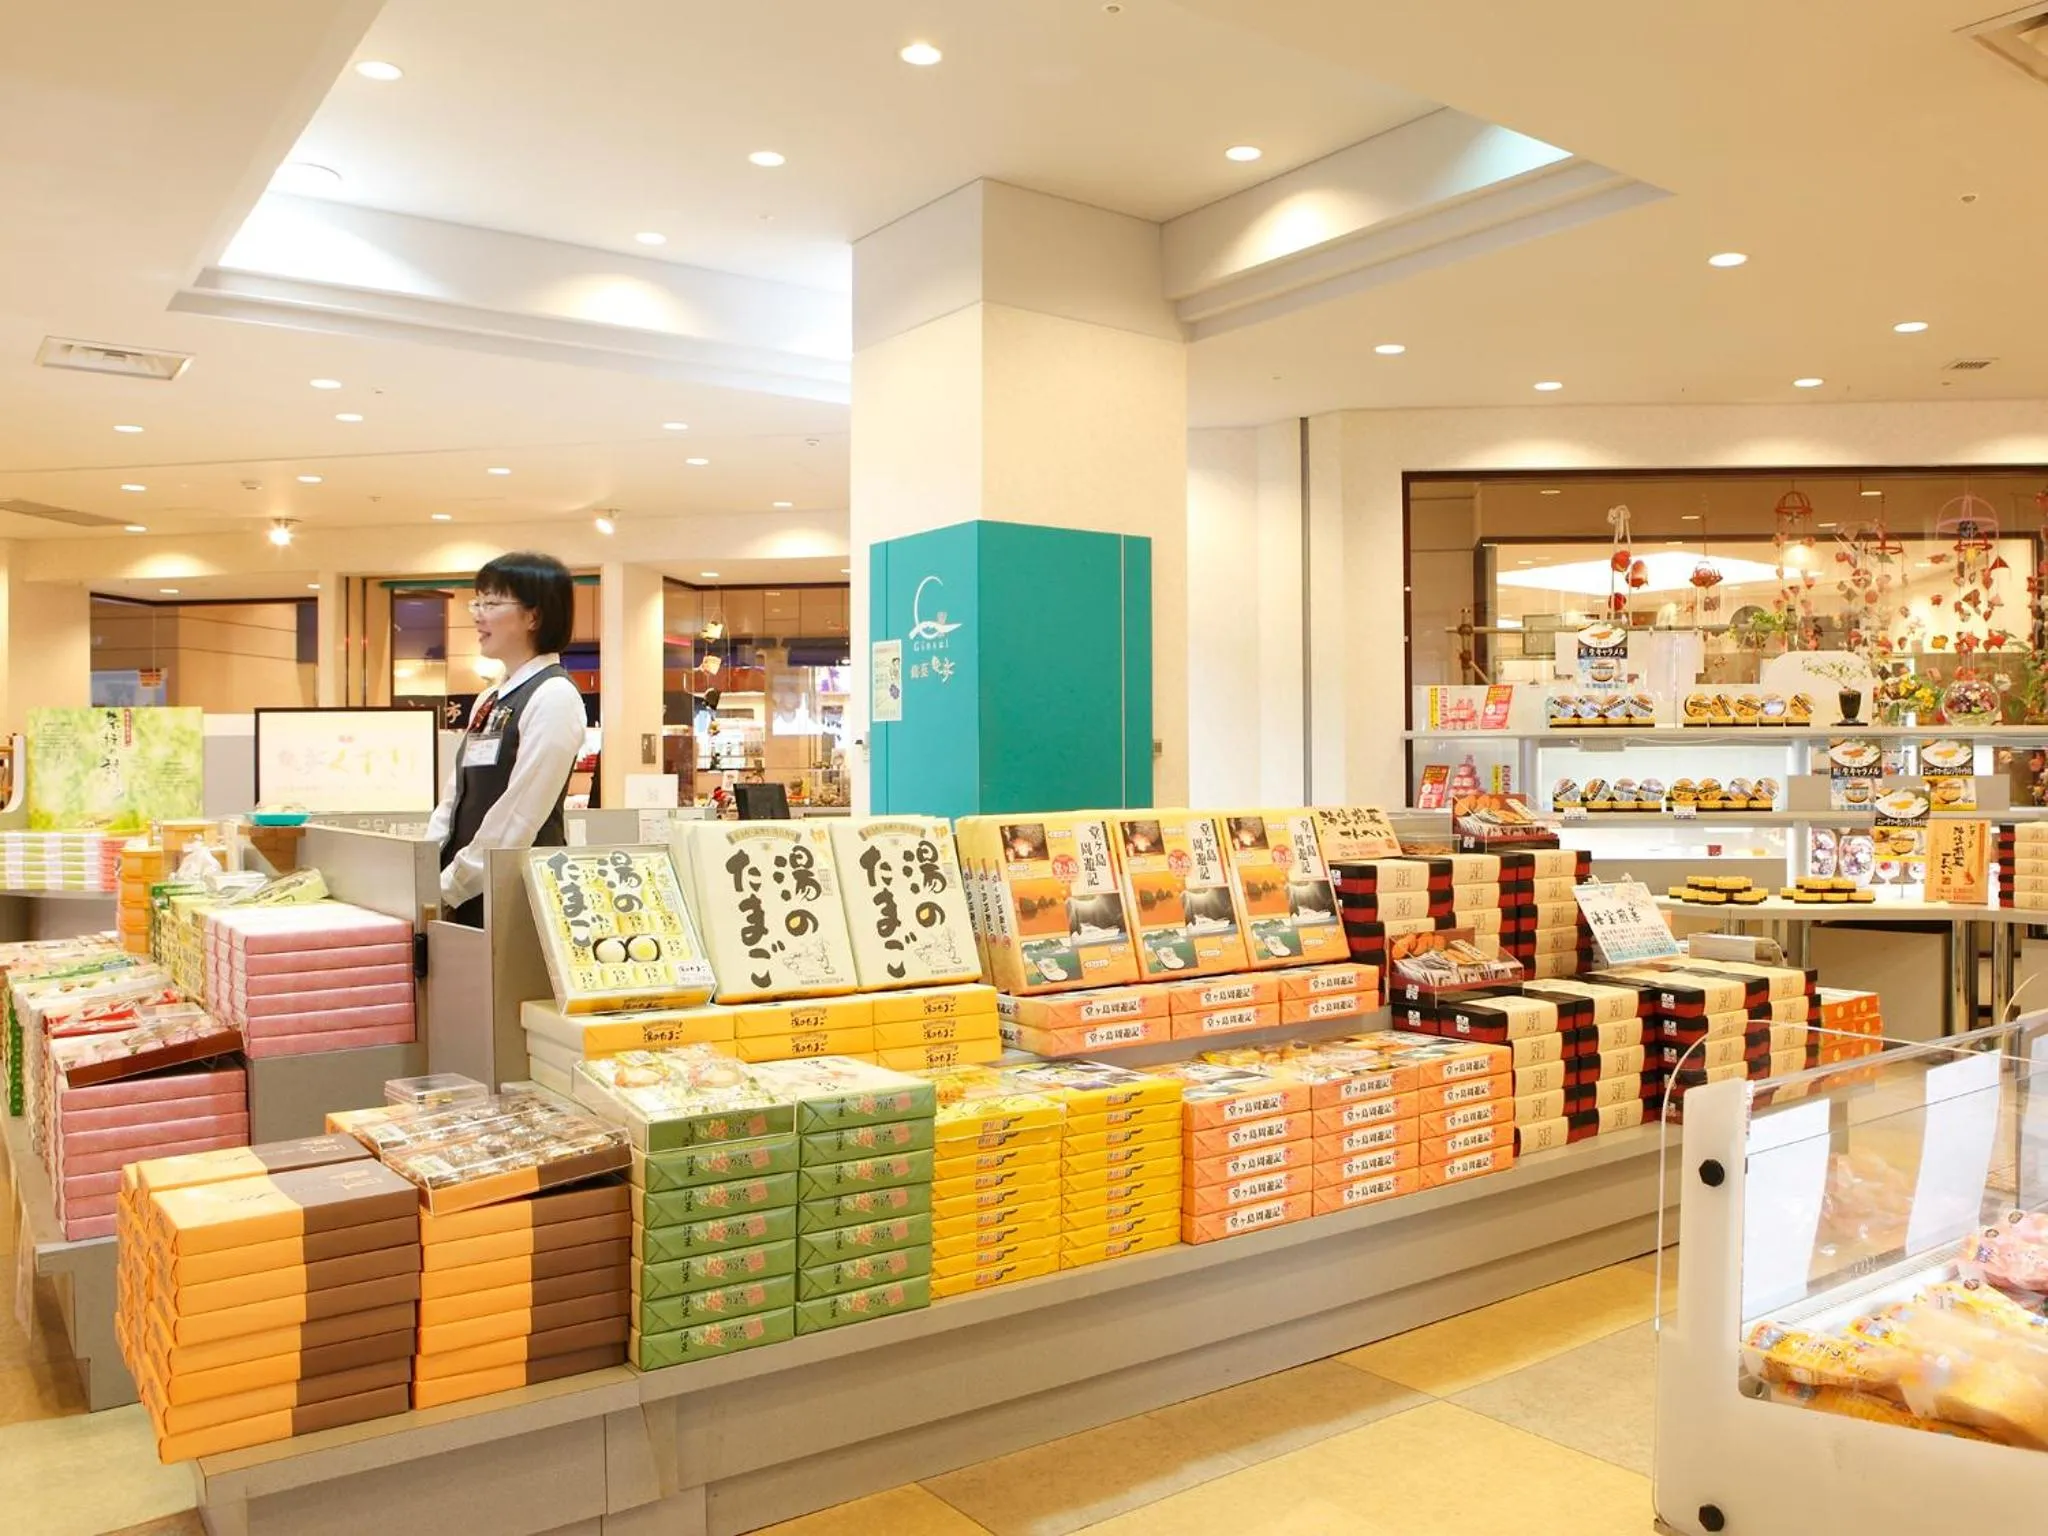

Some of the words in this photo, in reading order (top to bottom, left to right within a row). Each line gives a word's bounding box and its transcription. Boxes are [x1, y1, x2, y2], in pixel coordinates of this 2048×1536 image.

[547, 852, 603, 947] たまご
[597, 851, 643, 912] 湯の
[725, 849, 785, 988] たまご
[773, 845, 822, 937] 湯の
[859, 845, 917, 979] たまご
[902, 840, 947, 928] 湯の
